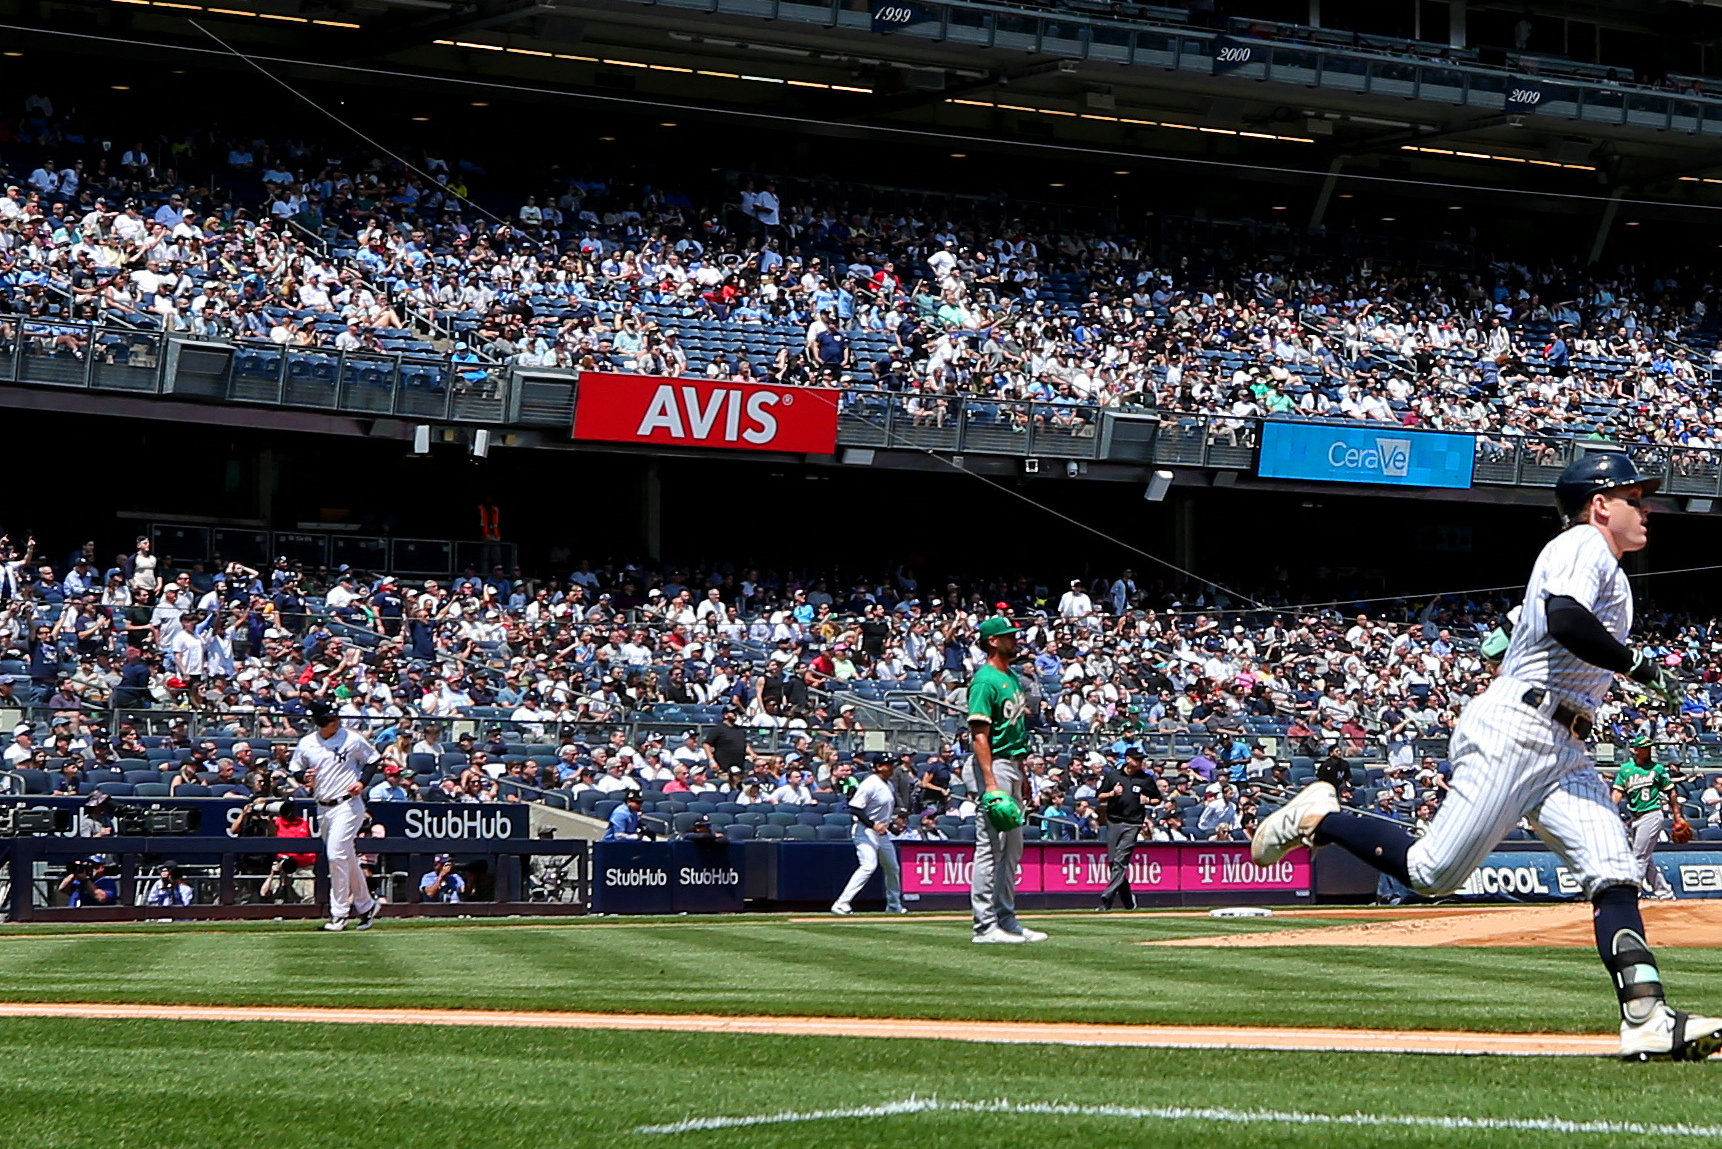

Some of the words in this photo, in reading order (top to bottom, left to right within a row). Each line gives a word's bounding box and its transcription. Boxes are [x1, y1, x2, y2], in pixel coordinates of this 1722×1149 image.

[874, 5, 912, 23] 1999
[1216, 47, 1251, 62] 2000
[1508, 88, 1540, 105] 2009
[637, 385, 781, 444] AVIS
[1328, 440, 1408, 470] CeraVe
[405, 809, 511, 839] StubHub
[606, 867, 667, 886] StubHub
[680, 866, 739, 886] StubHub
[1221, 853, 1294, 883] Mobile
[1483, 867, 1549, 895] COOL
